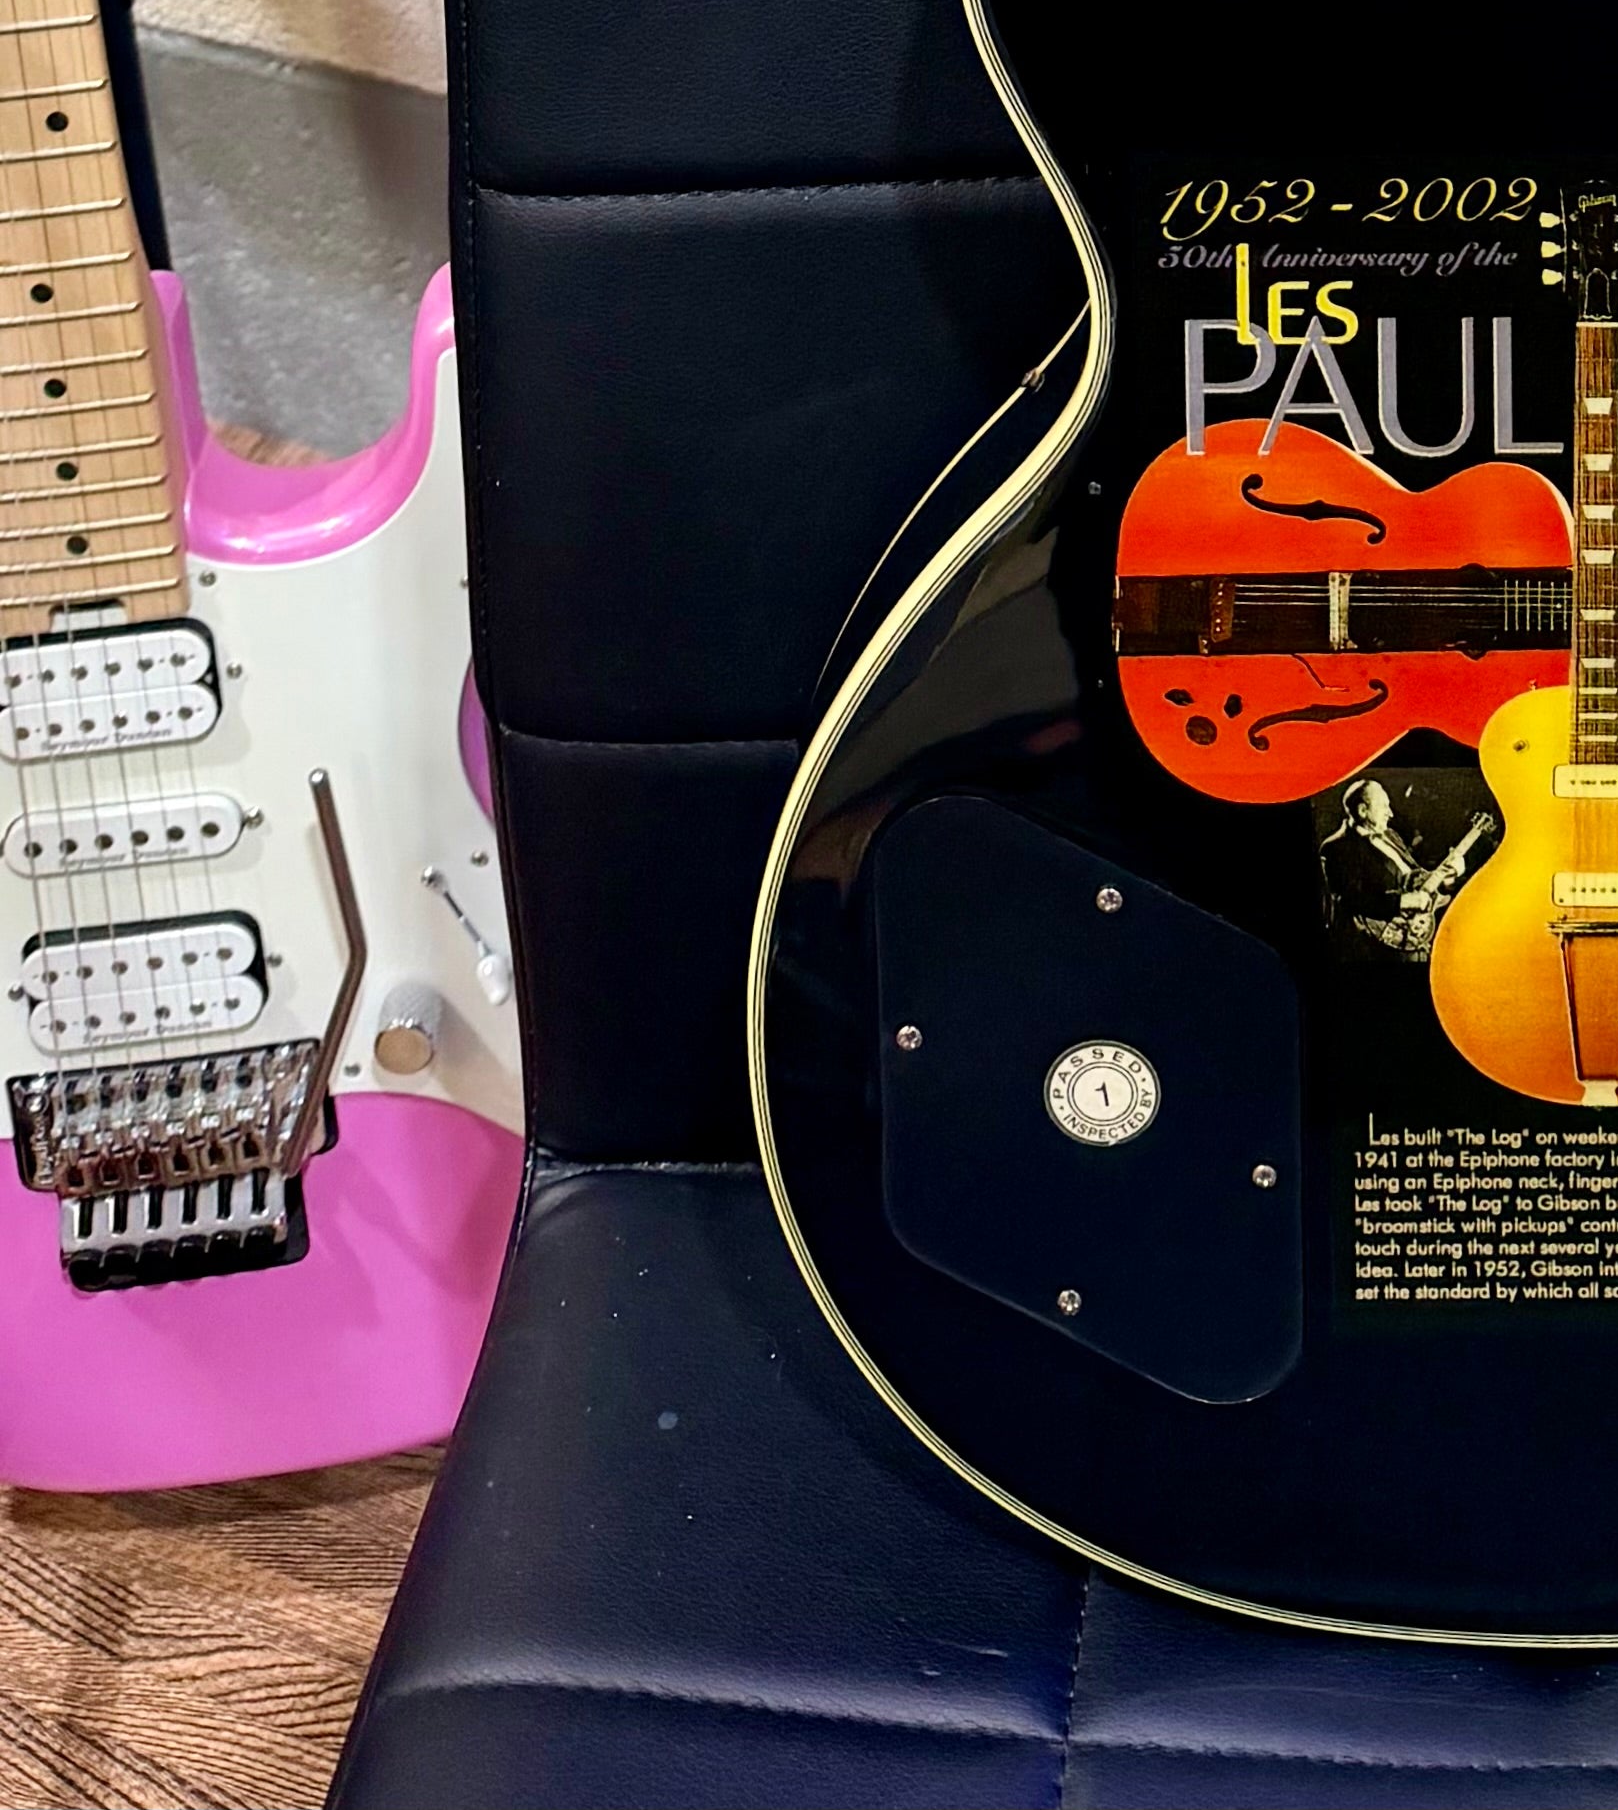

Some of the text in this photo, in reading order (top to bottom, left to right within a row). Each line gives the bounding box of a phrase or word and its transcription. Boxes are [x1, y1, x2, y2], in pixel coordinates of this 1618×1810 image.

[1157, 243, 1233, 269] 50th
[1437, 242, 1478, 277] of
[1471, 241, 1519, 267] the
[1184, 315, 1565, 458] PAUL
[1052, 1048, 1142, 1100] PASSED
[1094, 1081, 1110, 1107] 1
[1063, 1088, 1153, 1140] INSPECTED BY
[1368, 1112, 1400, 1146] Les
[1403, 1127, 1442, 1146] built
[1535, 1130, 1558, 1145] on
[1354, 1150, 1397, 1169] 1941
[1405, 1152, 1424, 1168] at
[1427, 1148, 1455, 1168] the
[1459, 1148, 1541, 1171] Epiphone
[1544, 1148, 1605, 1171] factory
[1354, 1173, 1400, 1194] using
[1403, 1175, 1427, 1190] an
[1432, 1171, 1513, 1194] Epiphone
[1518, 1171, 1565, 1192] neck,
[1354, 1194, 1381, 1213] Les
[1384, 1194, 1423, 1212] took
[1515, 1196, 1534, 1212] to
[1536, 1193, 1601, 1212] Gibson
[1460, 1216, 1497, 1234] with
[1354, 1237, 1401, 1256] touch
[1405, 1238, 1463, 1260] during
[1466, 1237, 1494, 1256] the
[1498, 1240, 1536, 1256] next
[1539, 1236, 1600, 1255] several
[1355, 1260, 1399, 1279] idea.
[1404, 1260, 1446, 1278] Later
[1451, 1261, 1468, 1278] in
[1474, 1260, 1527, 1279] 1952,
[1530, 1259, 1594, 1277] Gibson
[1355, 1285, 1380, 1300] set
[1383, 1282, 1410, 1300] the
[1415, 1281, 1491, 1300] standard
[1495, 1281, 1518, 1303] by
[1522, 1281, 1574, 1299] which
[1577, 1281, 1600, 1299] all
